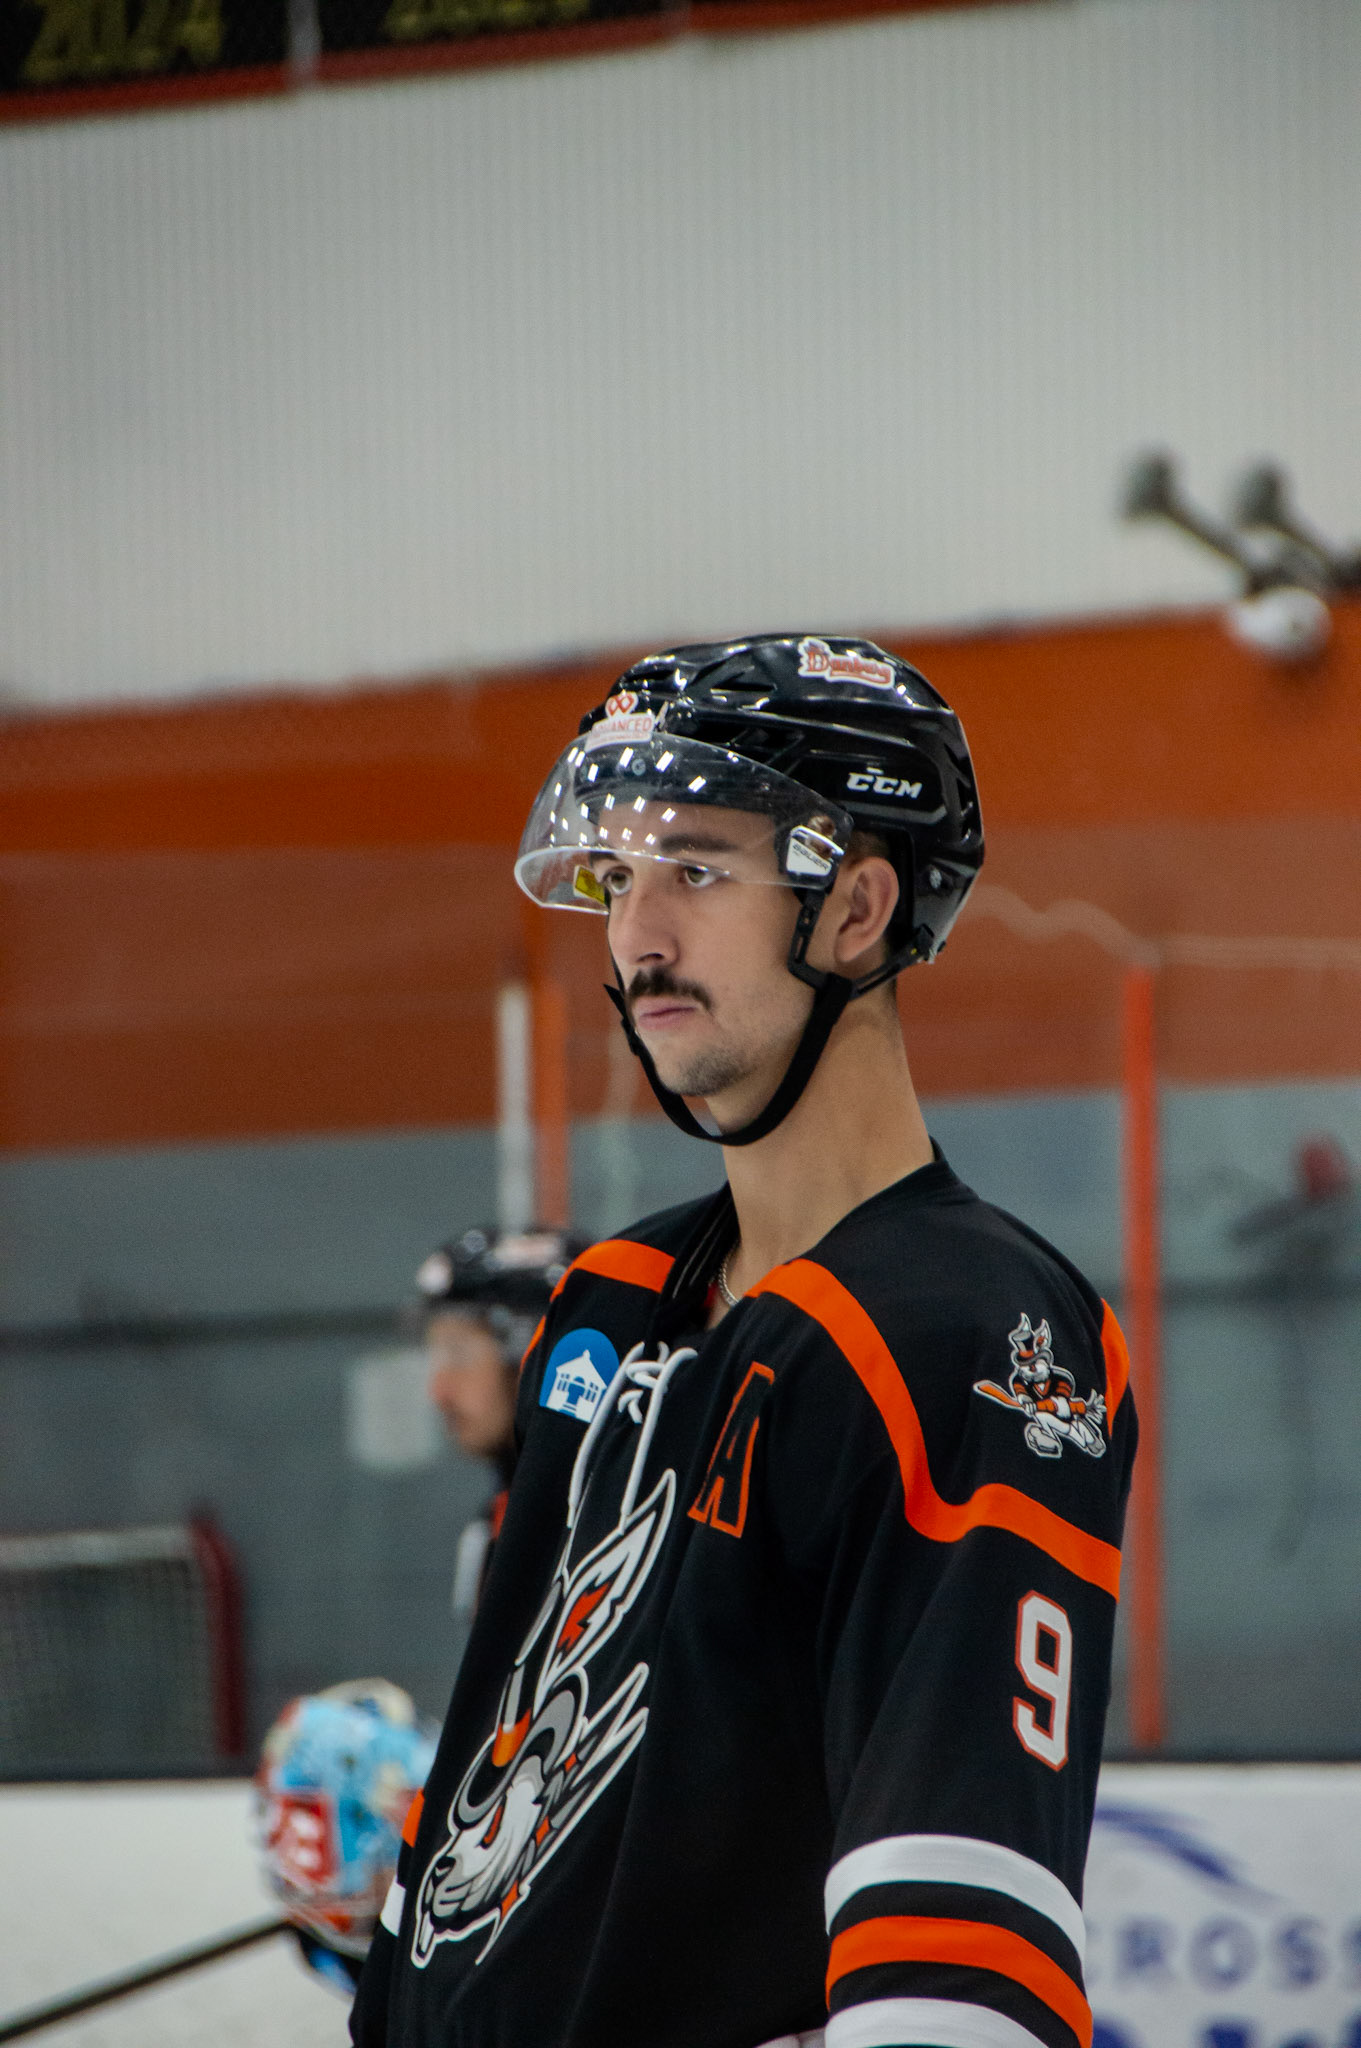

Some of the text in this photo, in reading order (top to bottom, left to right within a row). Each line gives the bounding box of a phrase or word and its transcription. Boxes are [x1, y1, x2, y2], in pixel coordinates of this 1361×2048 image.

[846, 771, 923, 799] CCM
[687, 1361, 775, 1538] A
[1012, 1589, 1073, 1773] 9
